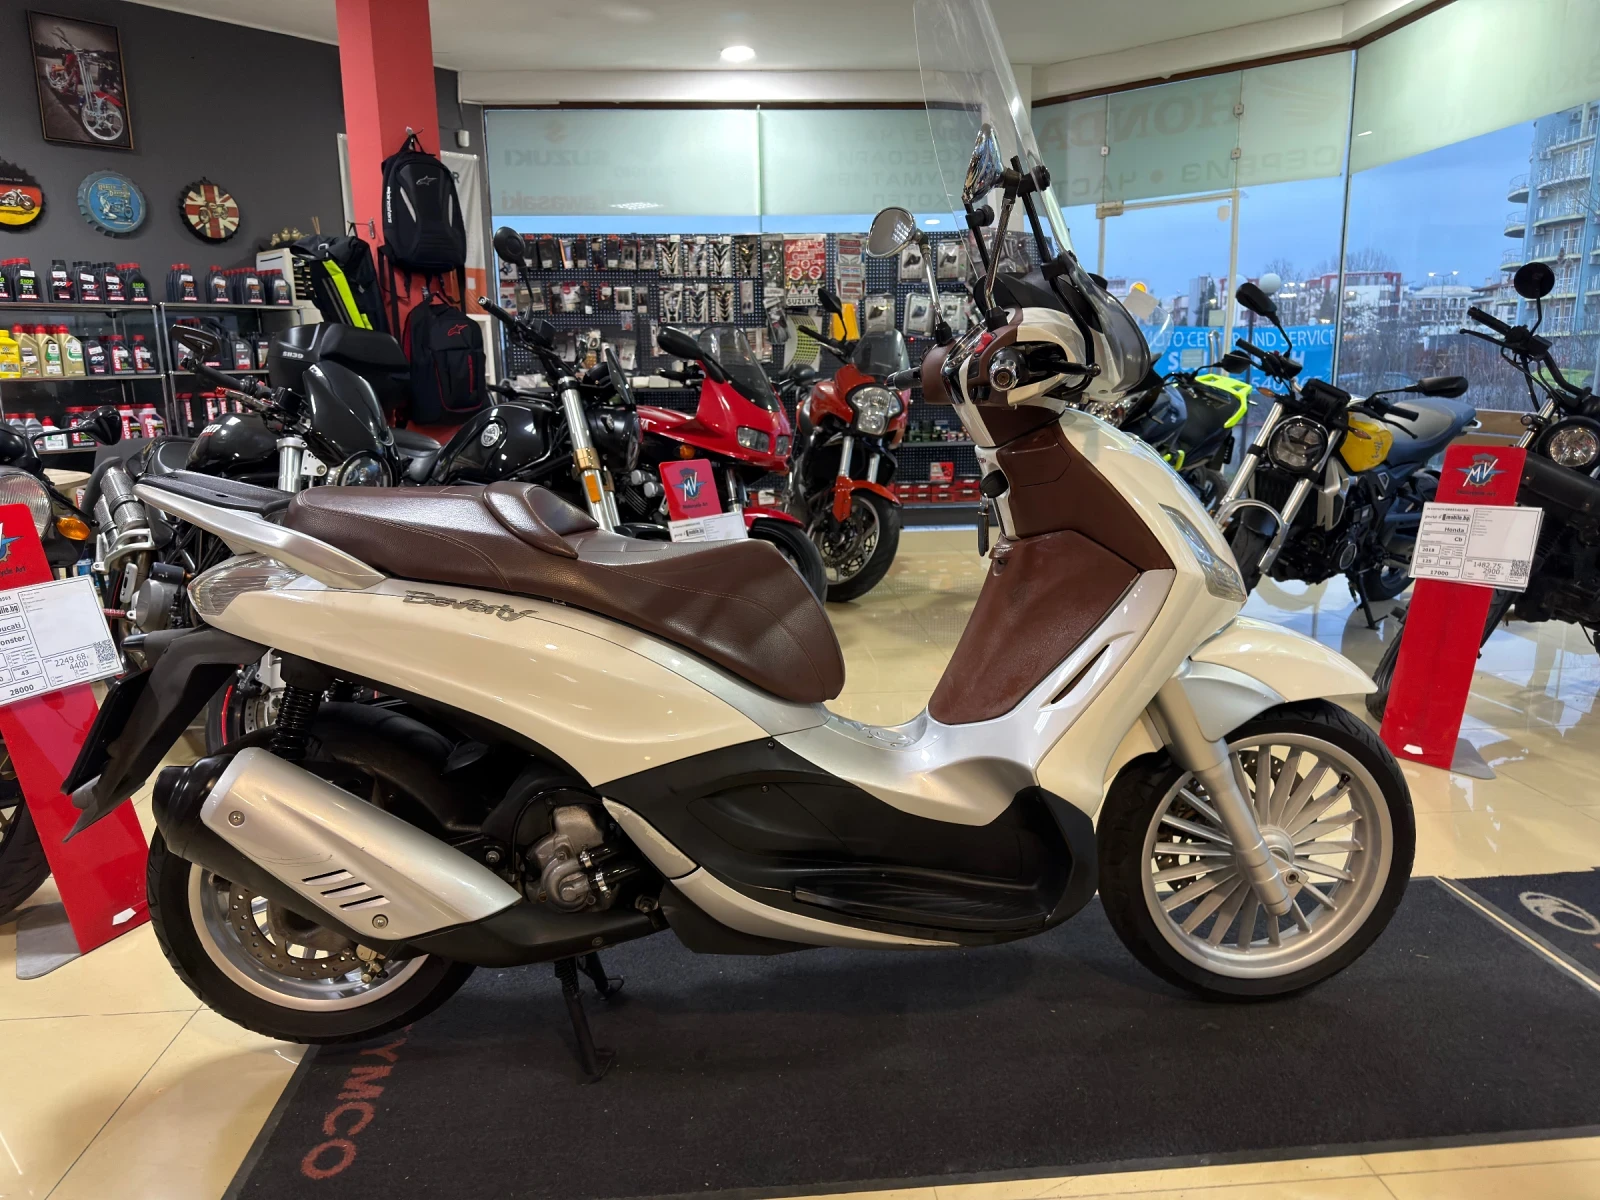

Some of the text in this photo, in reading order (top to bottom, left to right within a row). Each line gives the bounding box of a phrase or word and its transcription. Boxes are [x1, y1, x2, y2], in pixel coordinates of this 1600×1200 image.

[786, 298, 816, 306] SUZUKI
[1482, 567, 1501, 575] 2900
[0, 605, 19, 614] ile.bg
[403, 590, 539, 622] Beverly
[0, 635, 26, 646] onster
[55, 653, 87, 667] 2249.68
[69, 660, 89, 670] 4400
[10, 684, 34, 696] 28000
[301, 1036, 409, 1181] YMCO
